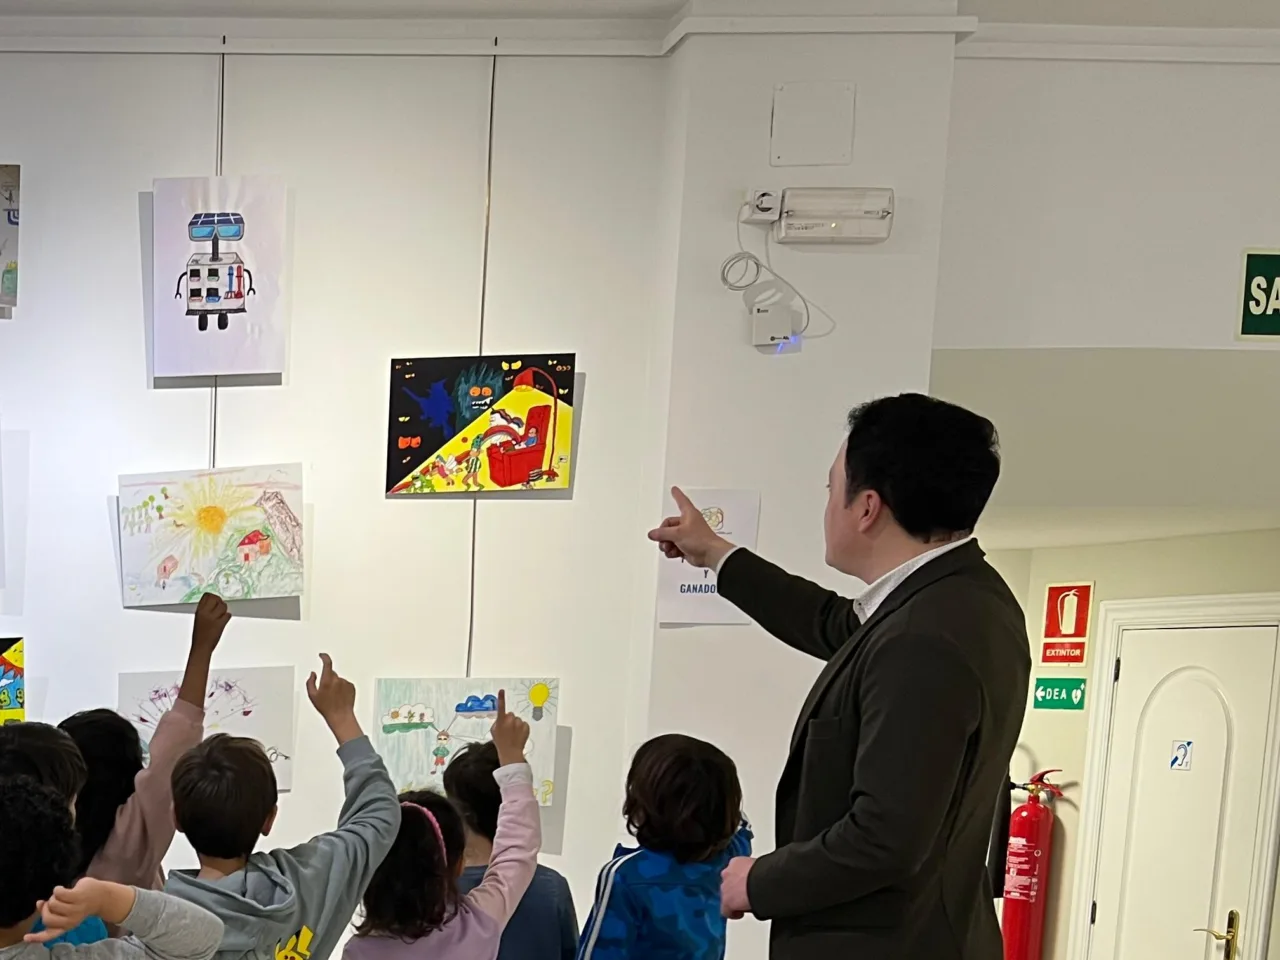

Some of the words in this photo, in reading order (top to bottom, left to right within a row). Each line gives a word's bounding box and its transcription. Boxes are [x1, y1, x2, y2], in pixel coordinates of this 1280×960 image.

[1249, 276, 1280, 315] SA
[703, 569, 710, 579] Y
[680, 584, 717, 594] GANADO
[1045, 648, 1081, 657] EXTINTOR
[1046, 688, 1067, 700] DEA
